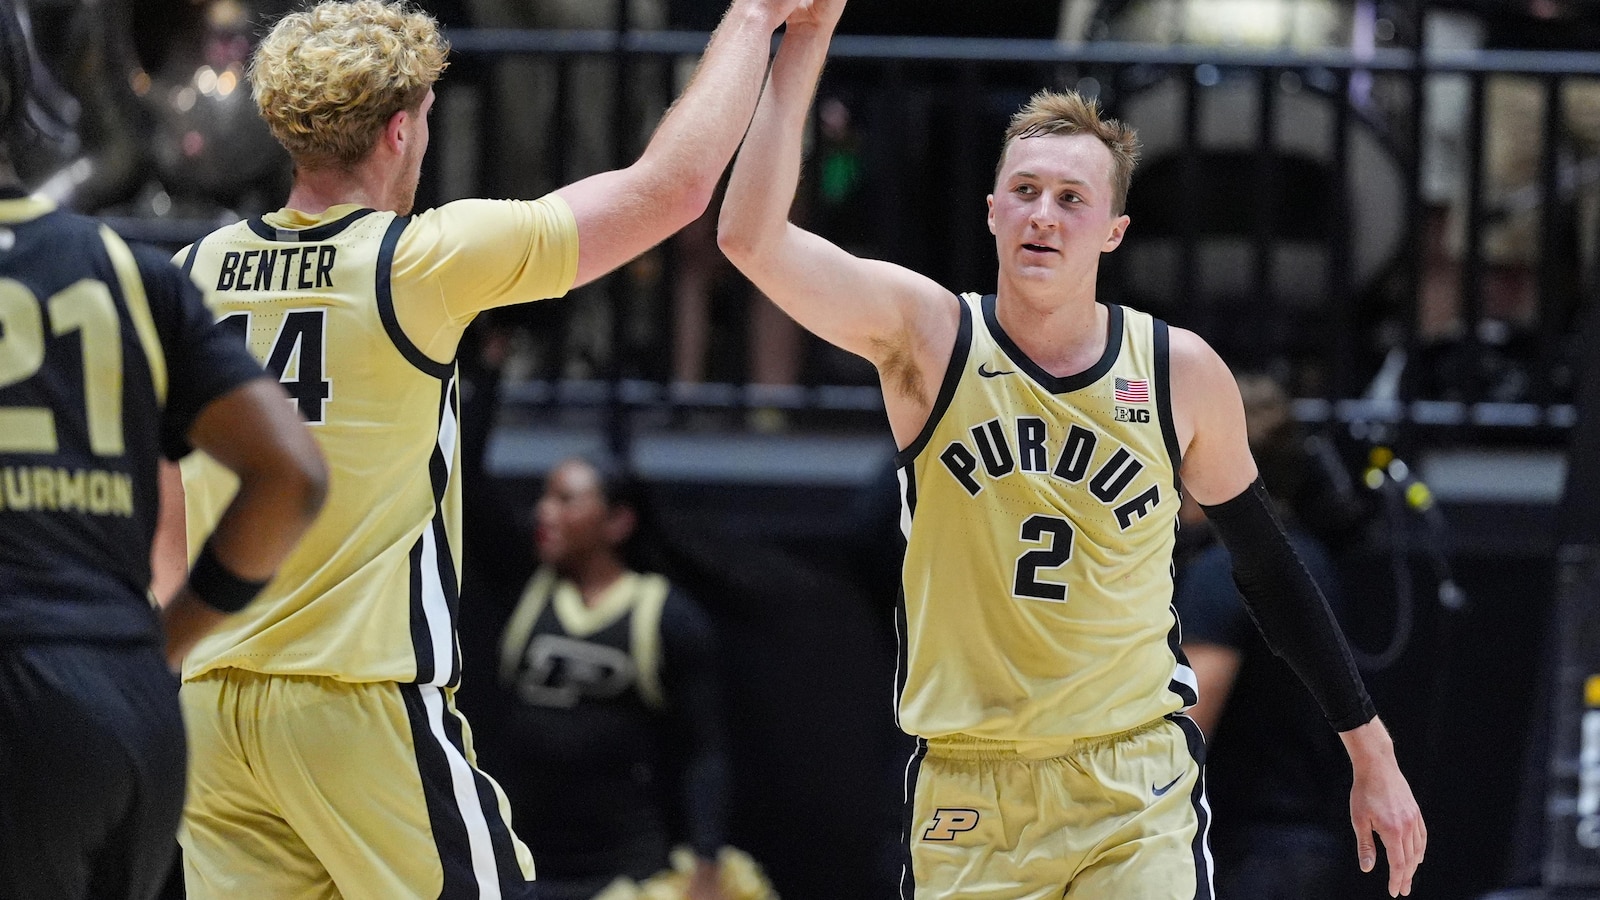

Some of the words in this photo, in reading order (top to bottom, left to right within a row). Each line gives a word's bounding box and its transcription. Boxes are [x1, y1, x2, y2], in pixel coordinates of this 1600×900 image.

[216, 245, 337, 291] BENTER
[0, 278, 125, 456] 21
[213, 307, 333, 426] 4
[0, 465, 134, 518] URMON
[938, 415, 1161, 534] PURDUE
[1011, 513, 1075, 603] 2
[921, 807, 980, 841] P
